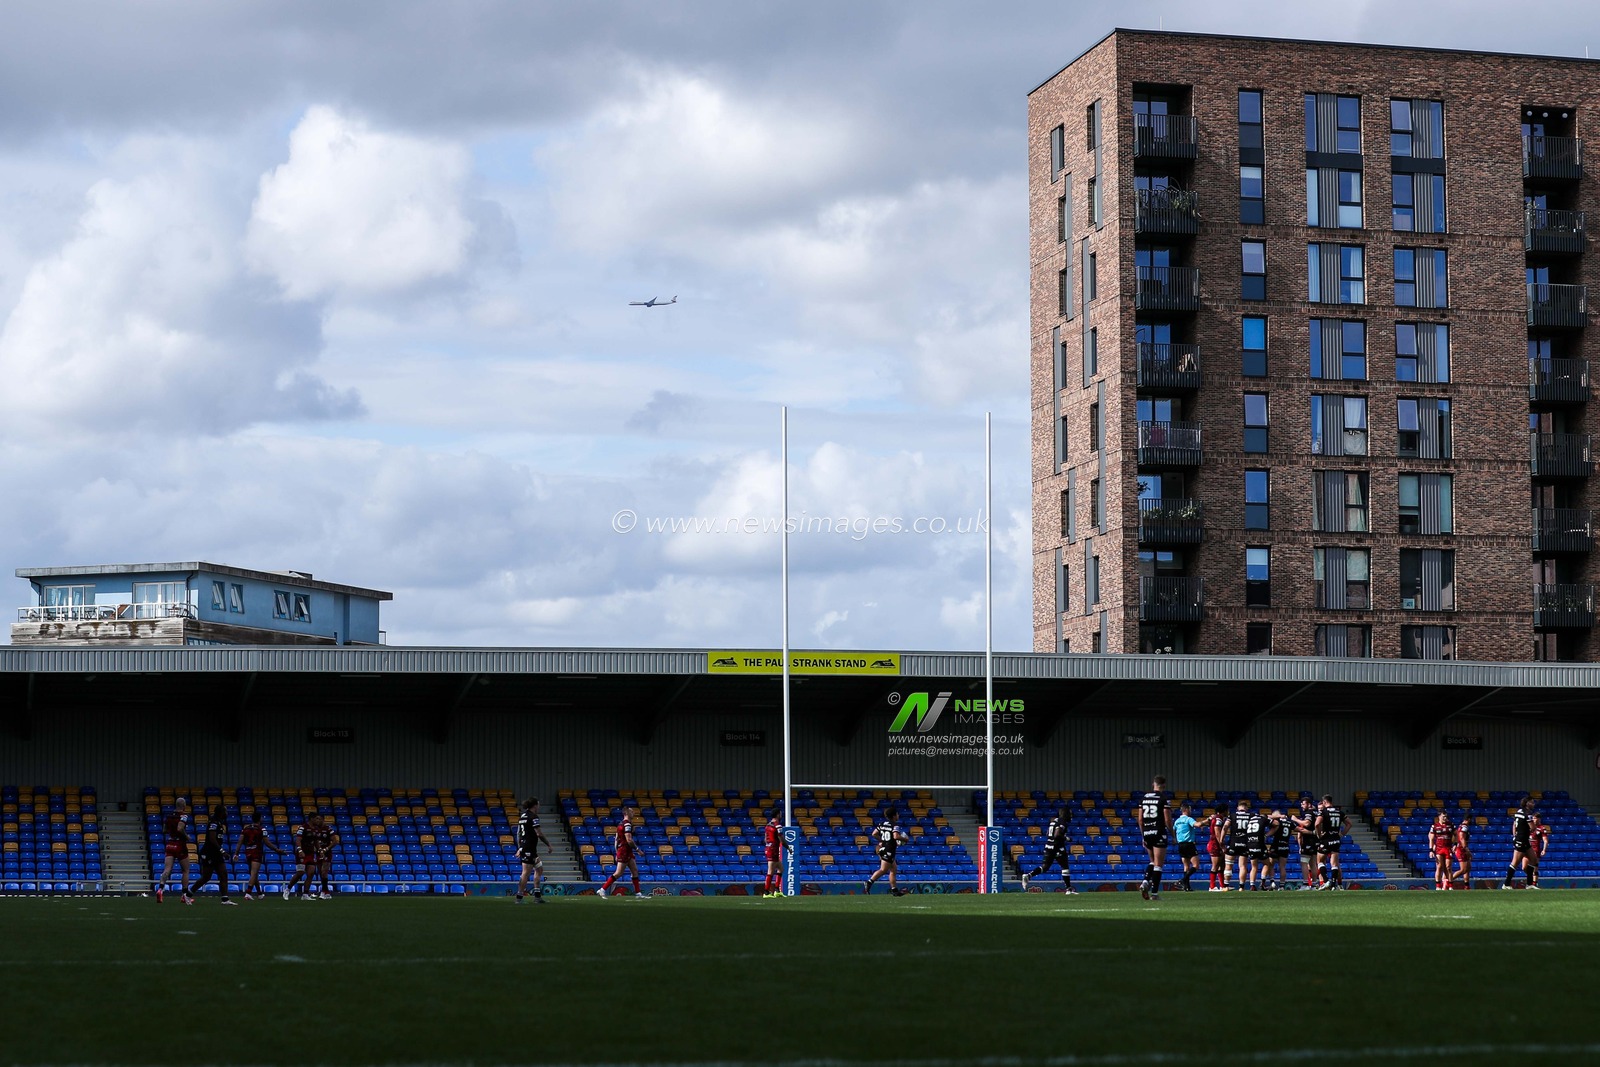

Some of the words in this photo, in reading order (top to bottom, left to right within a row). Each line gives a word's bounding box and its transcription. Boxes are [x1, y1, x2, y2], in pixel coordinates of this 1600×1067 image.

[743, 658, 764, 667] THE
[765, 658, 791, 667] PAU
[792, 658, 832, 668] STRANK
[834, 659, 867, 668] STAND
[313, 730, 336, 738] Block
[725, 733, 748, 741] Block
[749, 733, 761, 741] 114
[1128, 735, 1149, 743] Block
[1447, 737, 1467, 745] Block
[1142, 805, 1158, 818] 23
[1330, 817, 1340, 827] 11
[1246, 822, 1260, 834] 29
[1282, 827, 1290, 837] 9
[880, 830, 891, 841] 20
[787, 844, 795, 896] BETFRED
